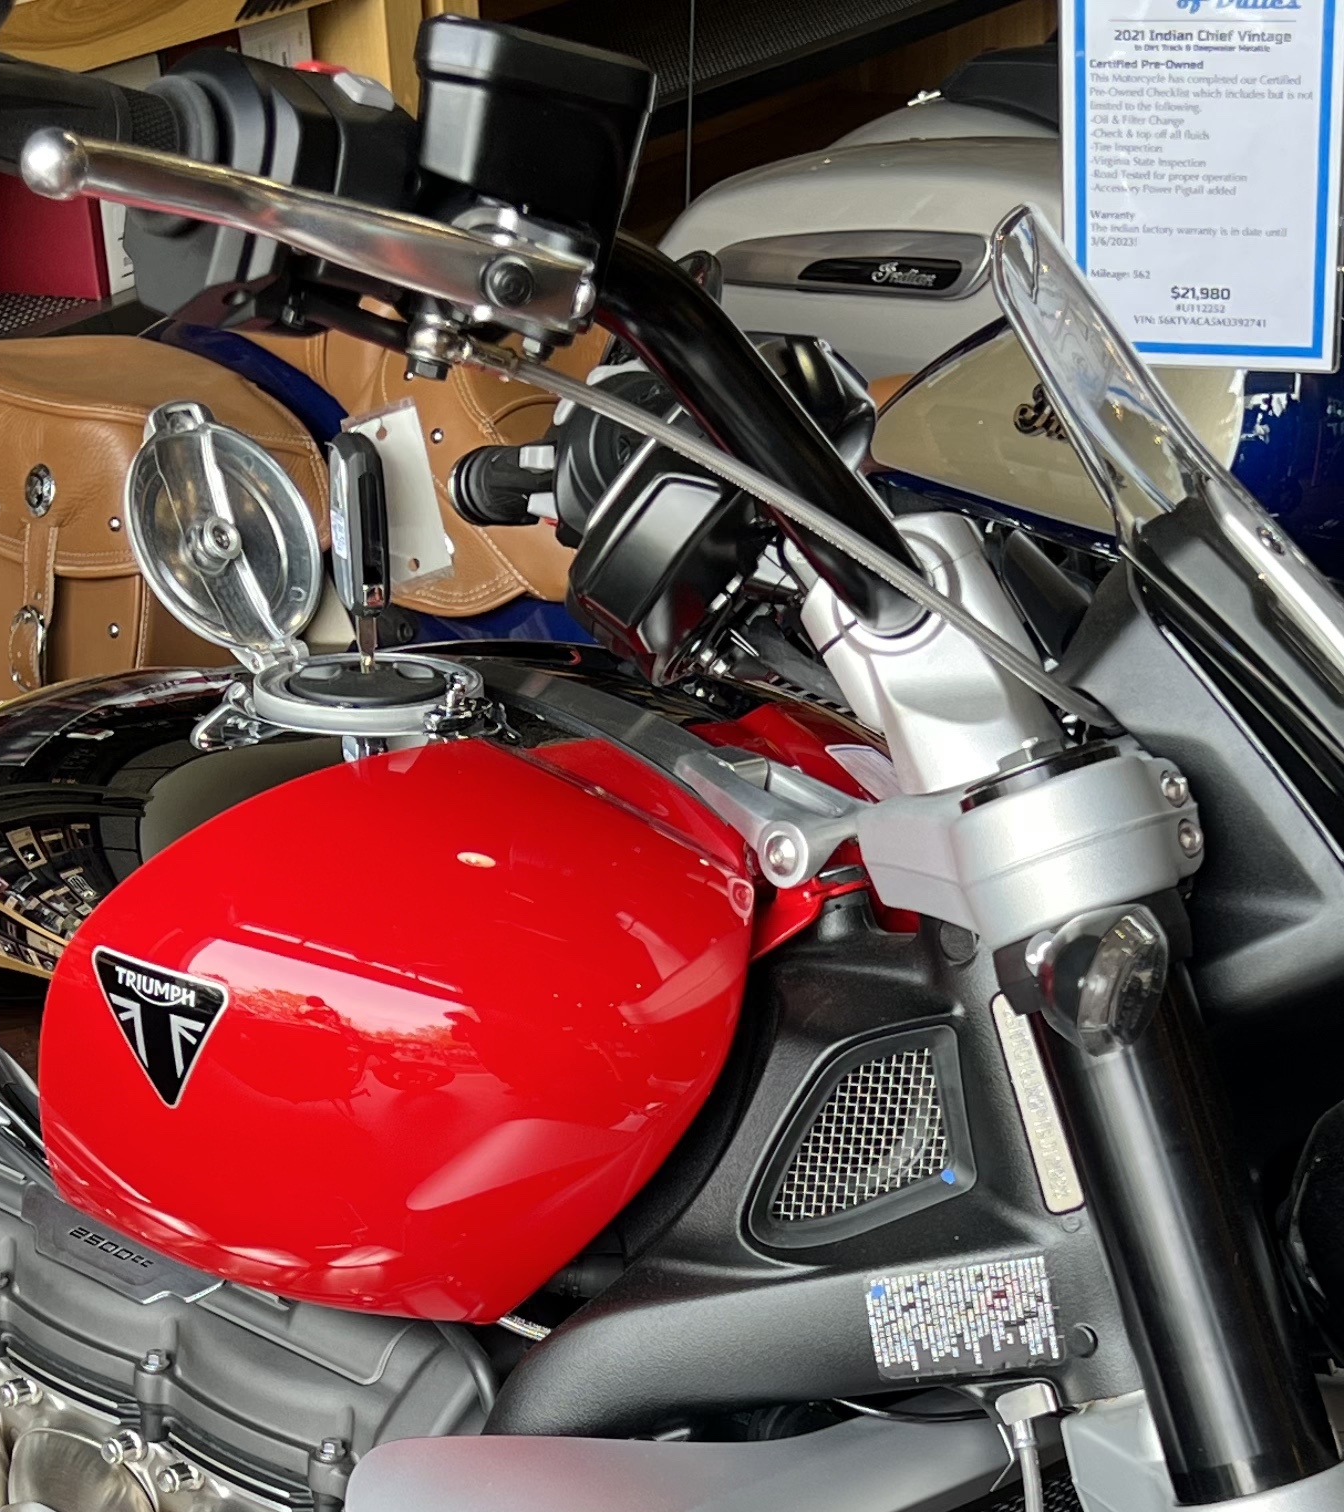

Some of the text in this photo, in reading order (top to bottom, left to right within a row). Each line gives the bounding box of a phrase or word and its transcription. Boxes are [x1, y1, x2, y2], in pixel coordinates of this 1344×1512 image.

[1114, 29, 1292, 45] 2021 Indian Chief Vintage
[1089, 60, 1204, 69] Certified Pre-Owned
[1090, 73, 1301, 86] This Motorcycle has completed our Certified
[1089, 87, 1144, 97] Pre-Owned
[1146, 87, 1189, 97] Checklist
[1192, 88, 1222, 98] which
[1224, 88, 1265, 99] includes
[1267, 89, 1283, 99] but
[1297, 91, 1313, 100] not
[1090, 101, 1121, 110] limited
[1125, 102, 1135, 111] to
[1137, 101, 1152, 111] the
[1111, 115, 1119, 124] &
[1121, 115, 1146, 125] Filter
[1148, 115, 1185, 128] Change
[1126, 129, 1133, 138] &
[1136, 130, 1151, 141] top
[1154, 129, 1167, 139] off
[1169, 130, 1181, 139] all
[1184, 130, 1210, 140] fluids
[1114, 143, 1163, 155] Inspection
[1133, 157, 1155, 166] State
[1158, 157, 1206, 169] Inspection
[1121, 170, 1150, 180] Tested
[1153, 170, 1165, 180] for
[1168, 172, 1199, 183] proper
[1202, 172, 1247, 183] operation
[1142, 184, 1172, 194] Power
[1206, 185, 1237, 196] added
[1090, 210, 1136, 221] Warranty
[1090, 223, 1107, 232] The
[1110, 223, 1139, 233] Indian
[1142, 224, 1174, 237] factory
[1176, 226, 1217, 238] warranty
[1241, 227, 1262, 237] date
[1265, 227, 1287, 237] until
[871, 260, 938, 287] Indian
[1170, 285, 1231, 301] $21,980
[1134, 314, 1156, 324] VIN:
[114, 965, 196, 1008] TRIUMPH
[67, 1225, 155, 1271] 2500cc
